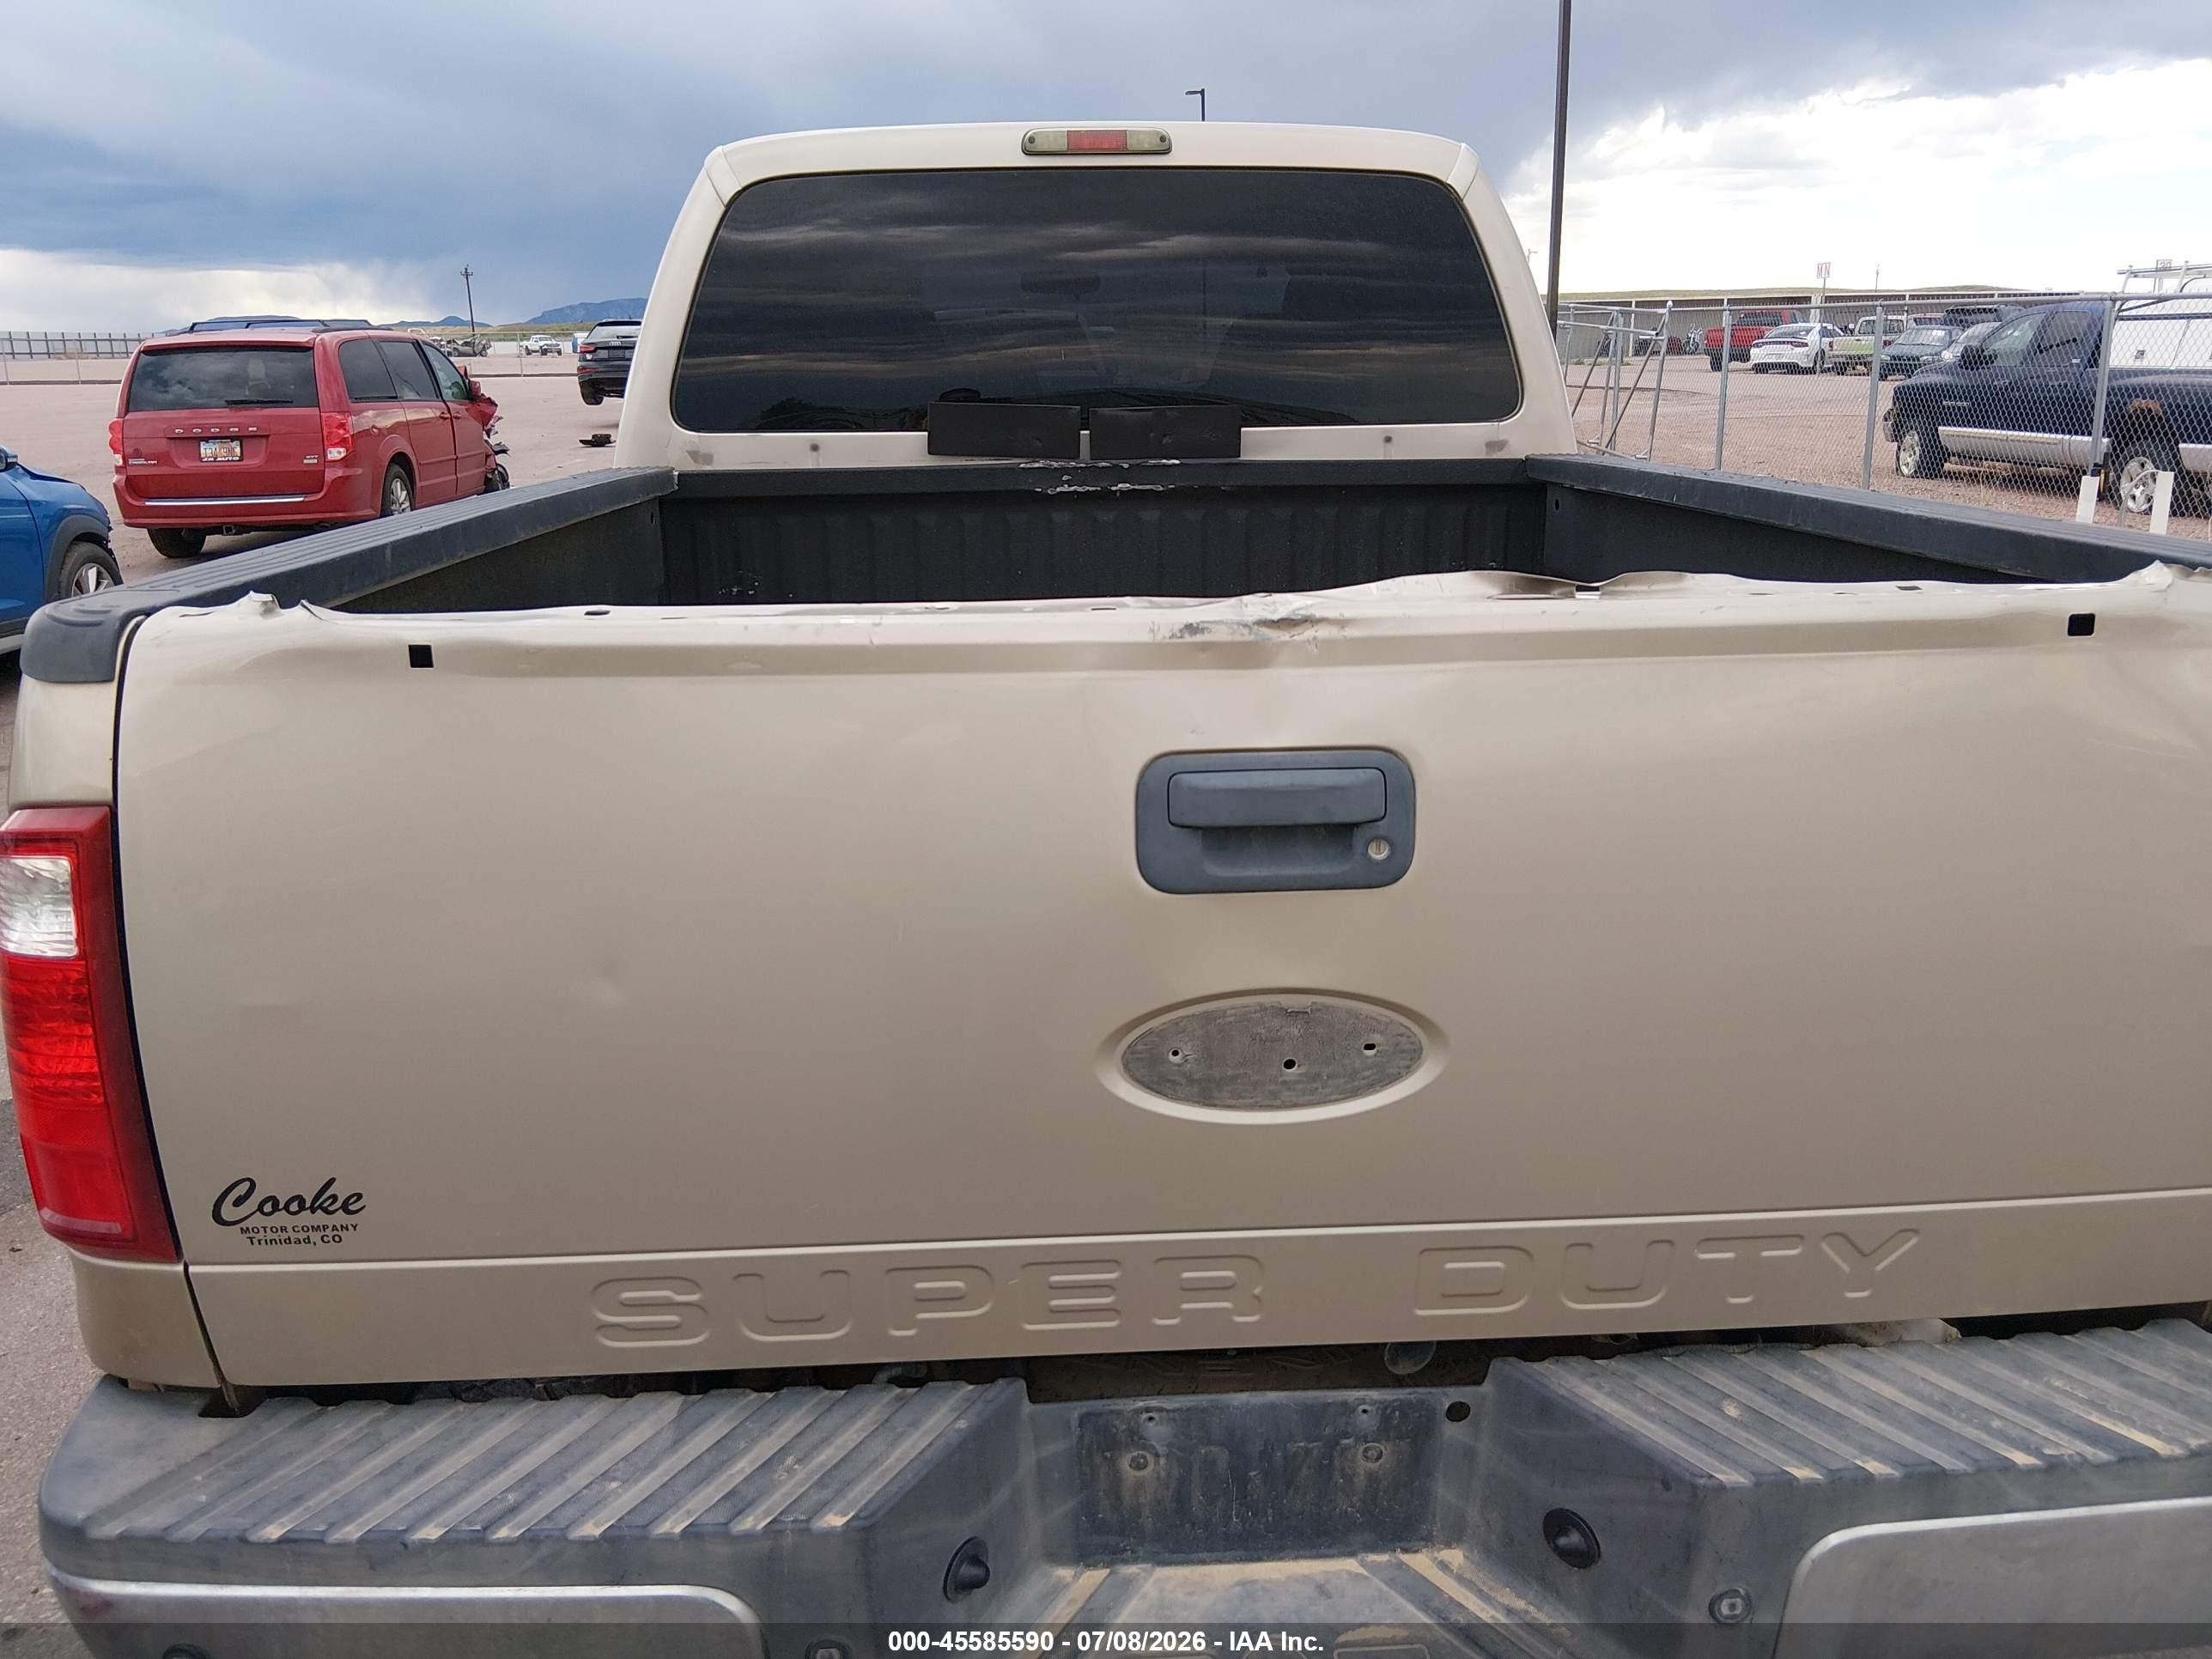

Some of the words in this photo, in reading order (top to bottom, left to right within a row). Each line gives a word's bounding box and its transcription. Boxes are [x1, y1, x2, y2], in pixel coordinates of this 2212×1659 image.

[212, 1176, 366, 1226] Cooke
[240, 1225, 289, 1235] MOTOR
[292, 1223, 359, 1233] COMPANY
[246, 1235, 317, 1246] Trinidad,
[320, 1234, 343, 1243] CO
[590, 1254, 1265, 1349] SUPER
[1413, 1228, 1922, 1316] DUTY
